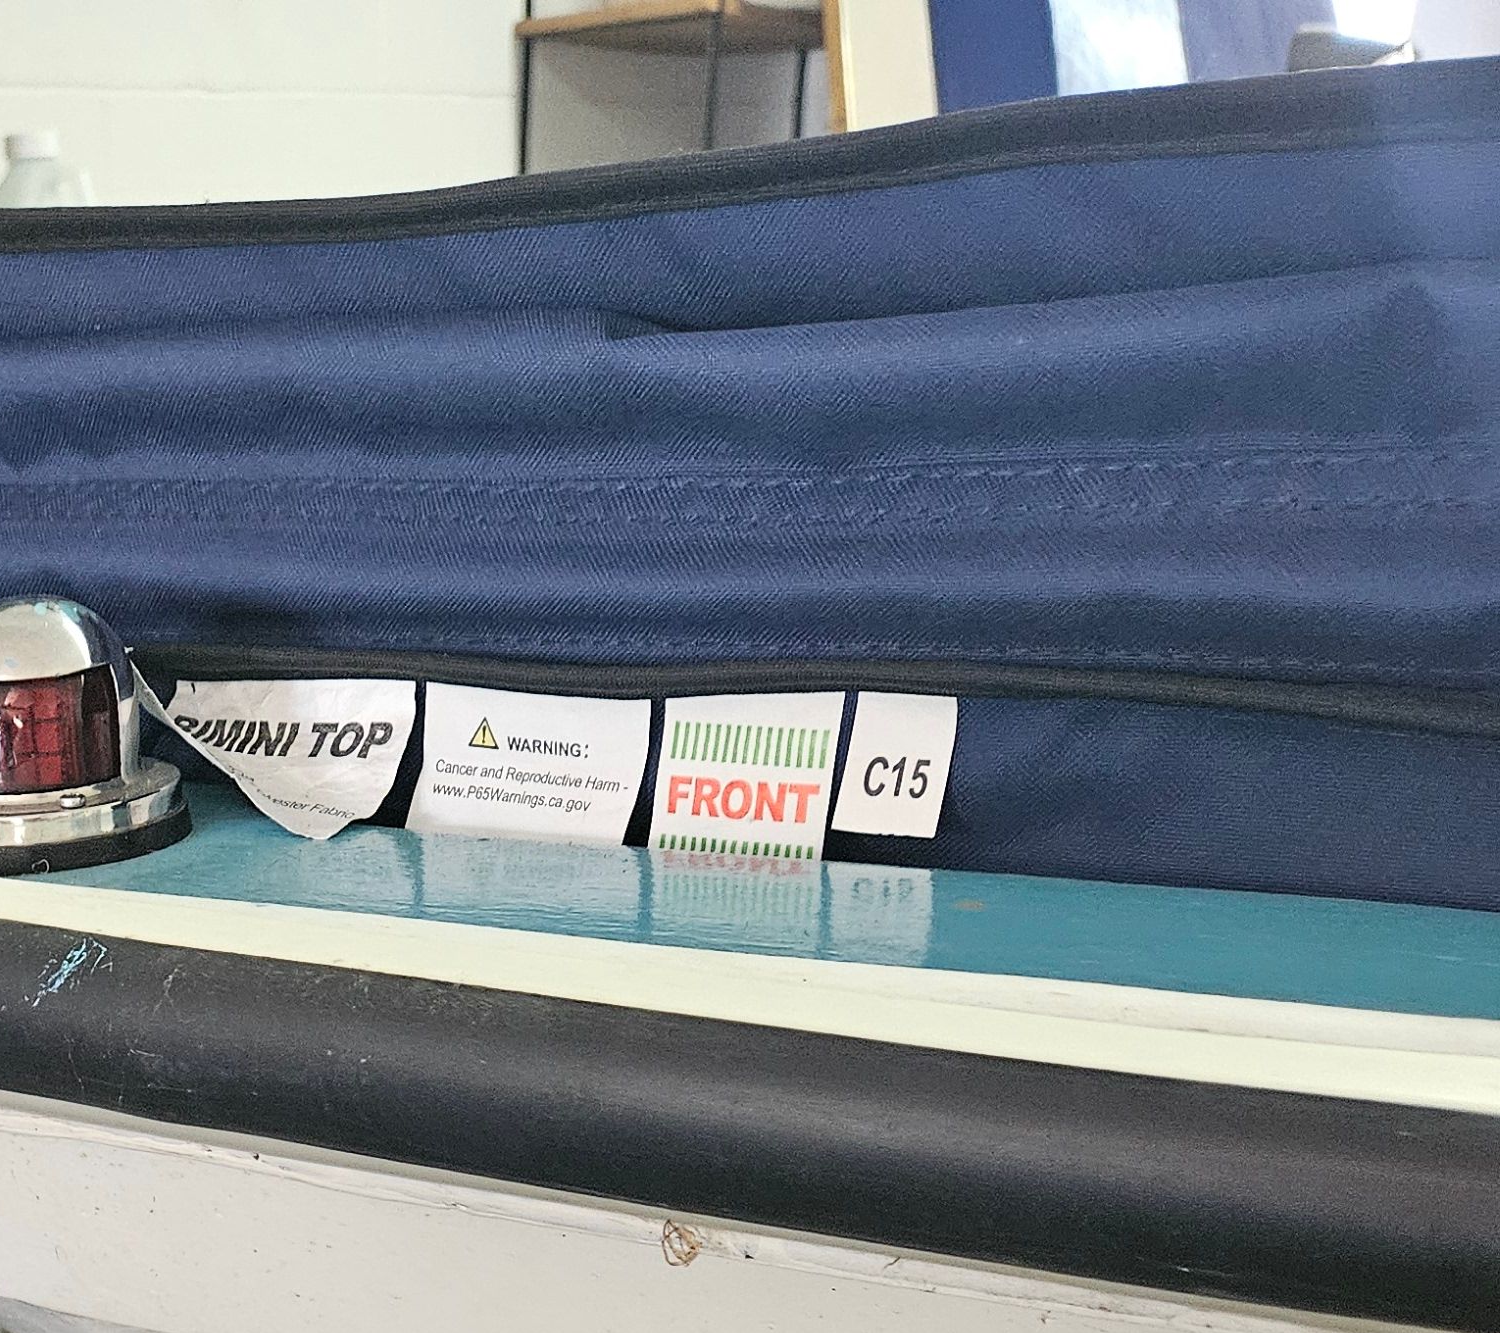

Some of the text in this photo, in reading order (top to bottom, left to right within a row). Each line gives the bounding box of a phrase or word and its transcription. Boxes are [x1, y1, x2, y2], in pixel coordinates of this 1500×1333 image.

[308, 721, 394, 759] TOP
[506, 735, 590, 759] WARNING:
[435, 758, 479, 777] Cancer
[480, 765, 504, 780] and
[505, 766, 583, 789] Reproductive
[584, 777, 621, 793] Harm
[863, 755, 932, 800] C15
[309, 802, 356, 819] Fabric
[432, 783, 592, 813] www.P65Warnings.ca.gov
[666, 774, 821, 824] FRONT
